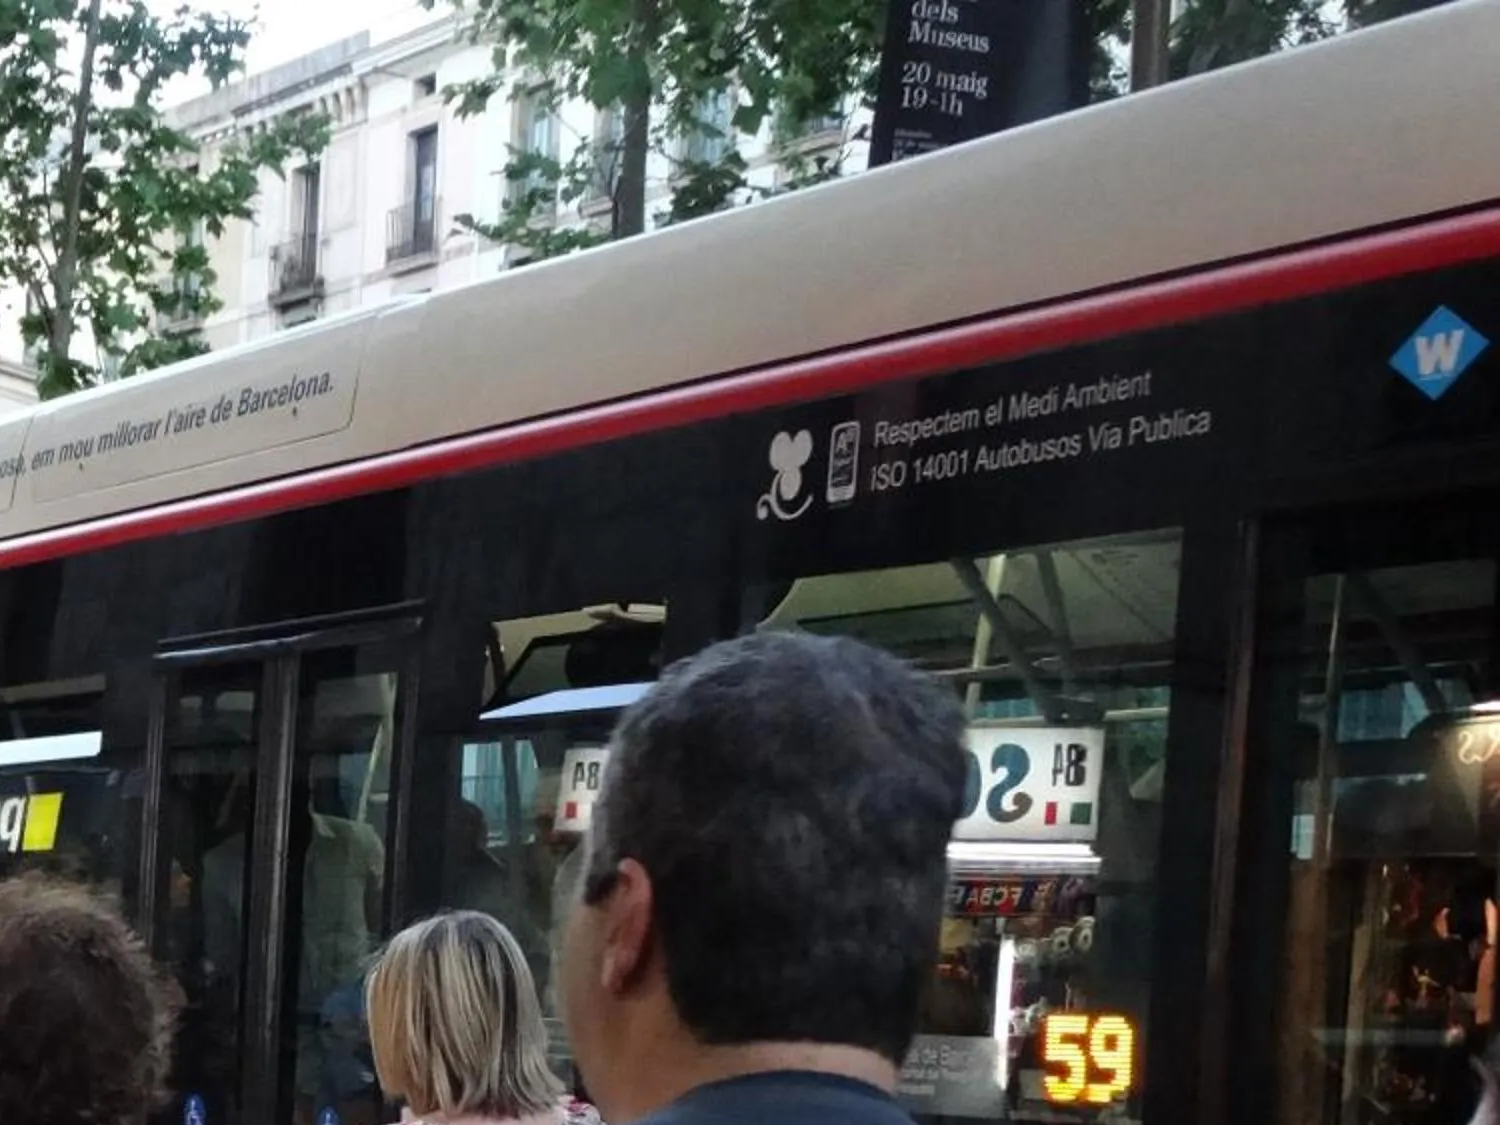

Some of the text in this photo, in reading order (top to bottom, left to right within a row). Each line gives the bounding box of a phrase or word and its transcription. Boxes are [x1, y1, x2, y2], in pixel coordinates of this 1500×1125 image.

[911, 0, 959, 21] dels
[907, 20, 990, 53] Museus
[901, 86, 963, 117] 19-1h
[902, 60, 988, 99] 20 maig
[1415, 328, 1465, 376] W
[31, 448, 55, 471] em
[59, 438, 95, 463] mou
[97, 418, 162, 452] millorar
[164, 407, 207, 435] l'aire
[210, 395, 232, 424] de
[237, 371, 334, 417] Barcelona.
[874, 368, 1152, 449] Respectem el Medi Ambient
[870, 460, 906, 492] ISO
[913, 449, 969, 483] 14001
[974, 430, 1082, 470] Autobusos
[1043, 1014, 1133, 1103] 59
